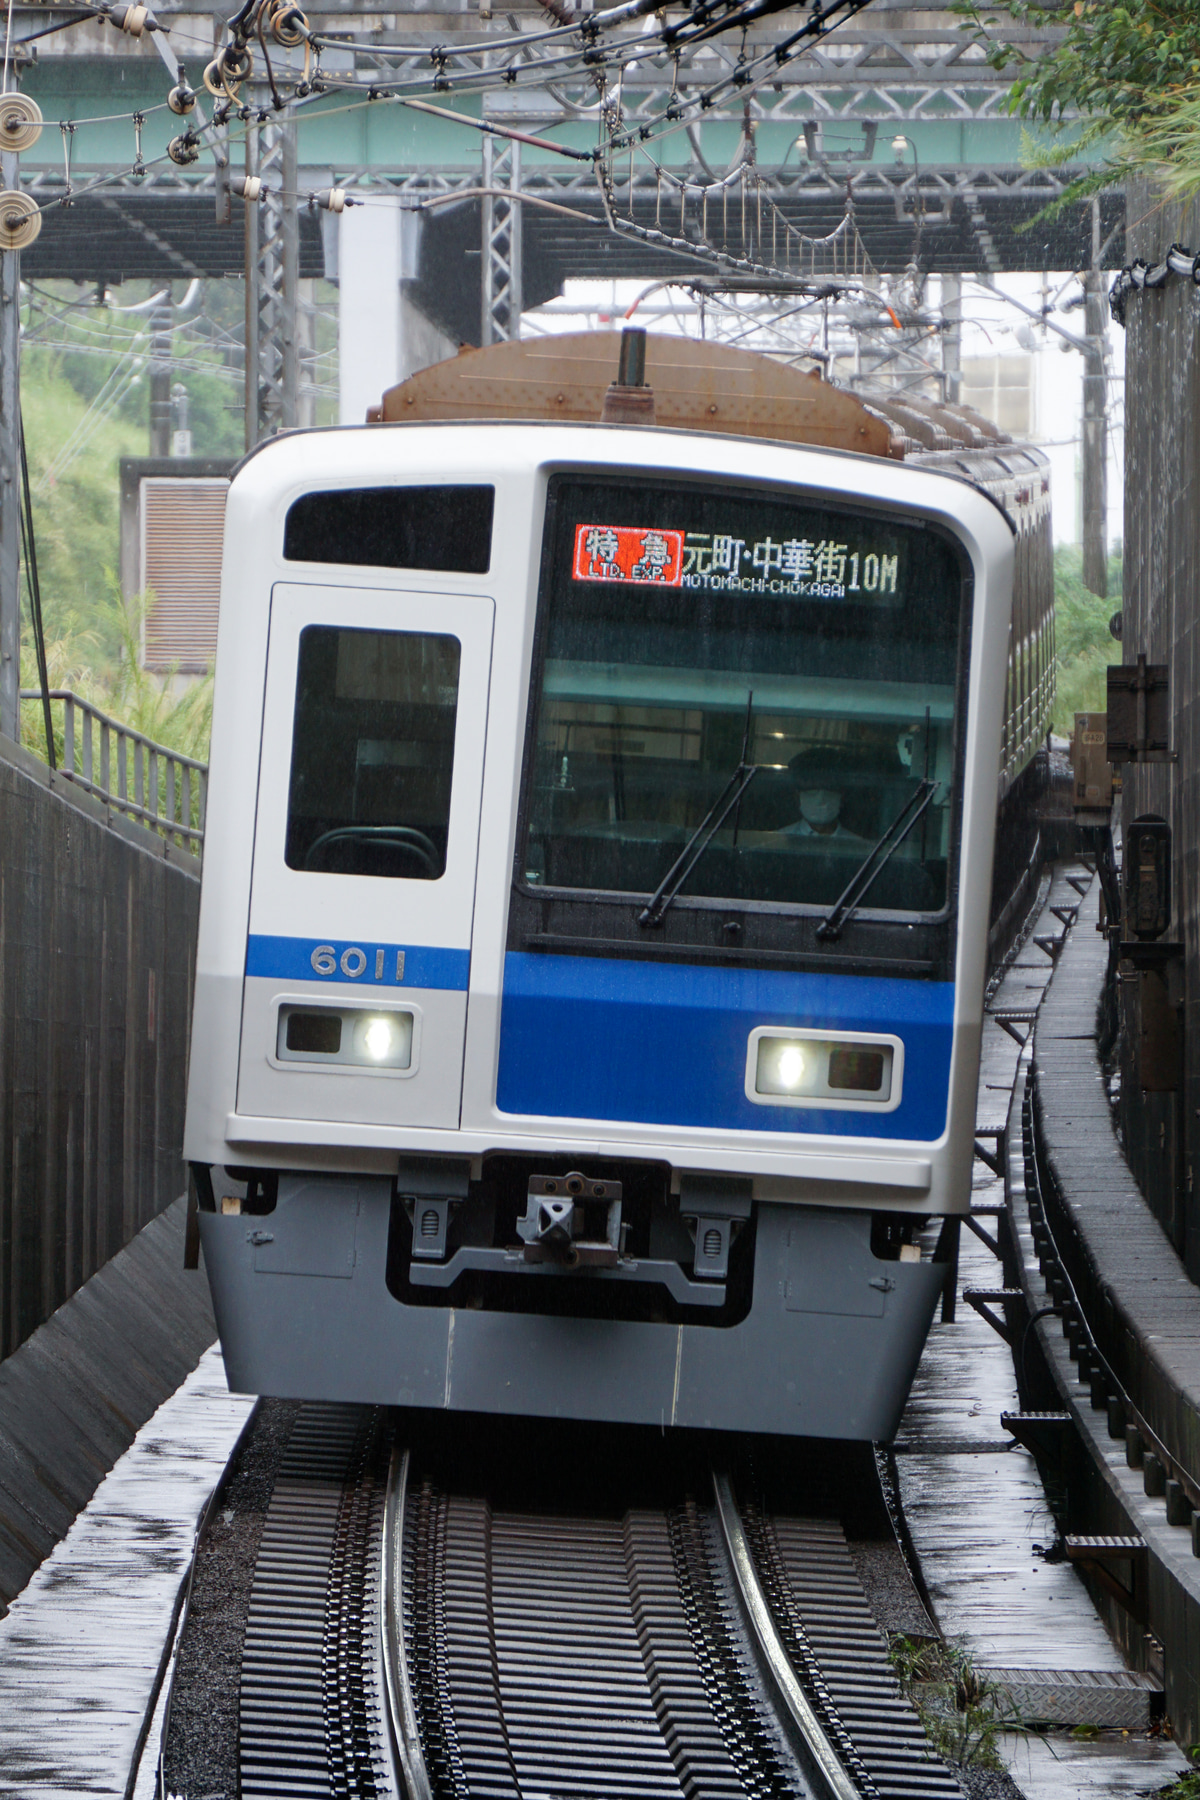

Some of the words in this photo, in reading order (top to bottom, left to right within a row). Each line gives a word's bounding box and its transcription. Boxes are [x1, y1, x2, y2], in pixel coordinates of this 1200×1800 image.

[586, 529, 673, 566] 特急
[588, 561, 626, 578] LTD.
[631, 564, 666, 581] EXP.
[848, 552, 899, 594] 10M
[310, 944, 406, 981] 6011
